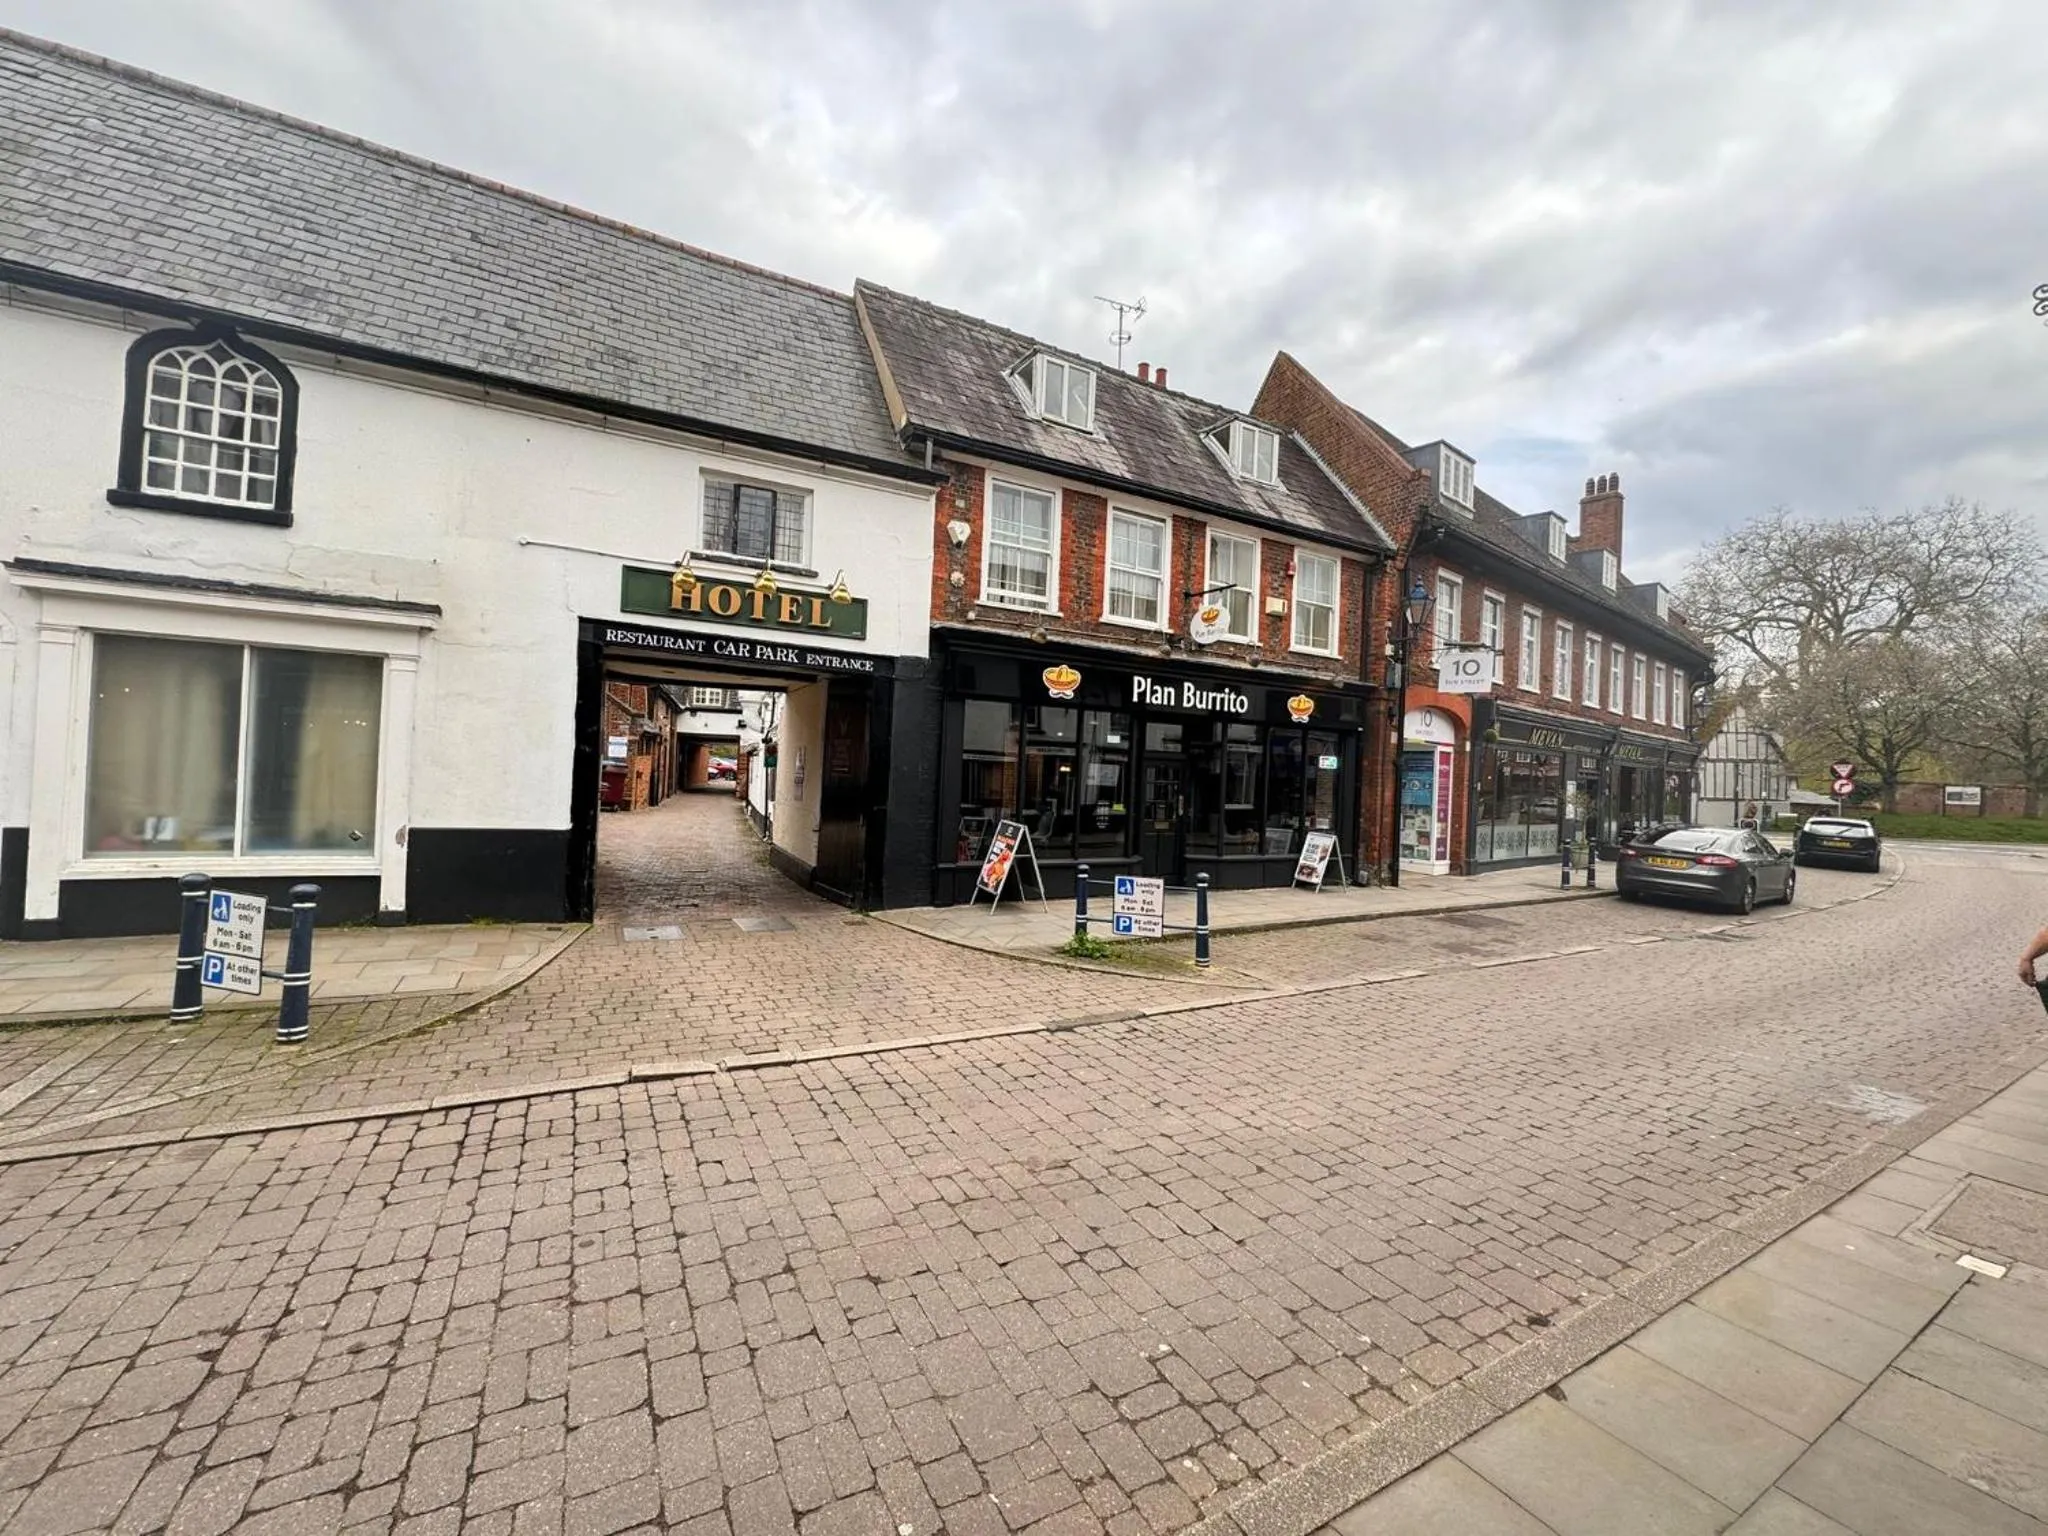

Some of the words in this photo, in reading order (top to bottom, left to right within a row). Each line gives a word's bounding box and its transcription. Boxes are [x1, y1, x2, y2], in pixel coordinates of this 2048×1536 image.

[670, 582, 833, 628] HOTEL
[605, 628, 706, 653] RESTAURANT
[713, 639, 751, 658] CAR
[754, 644, 799, 664] PARK
[806, 653, 874, 672] ENTRANCE
[1452, 660, 1480, 676] 10
[1132, 676, 1175, 706] Plan
[1182, 681, 1249, 713] Burrito
[233, 900, 262, 914] Loading
[238, 914, 254, 924] only
[217, 927, 233, 937] Mon
[239, 930, 252, 940] Sat
[219, 941, 231, 949] am
[243, 944, 253, 952] pm
[226, 961, 236, 971] At
[238, 965, 258, 975] other
[231, 973, 252, 985] times
